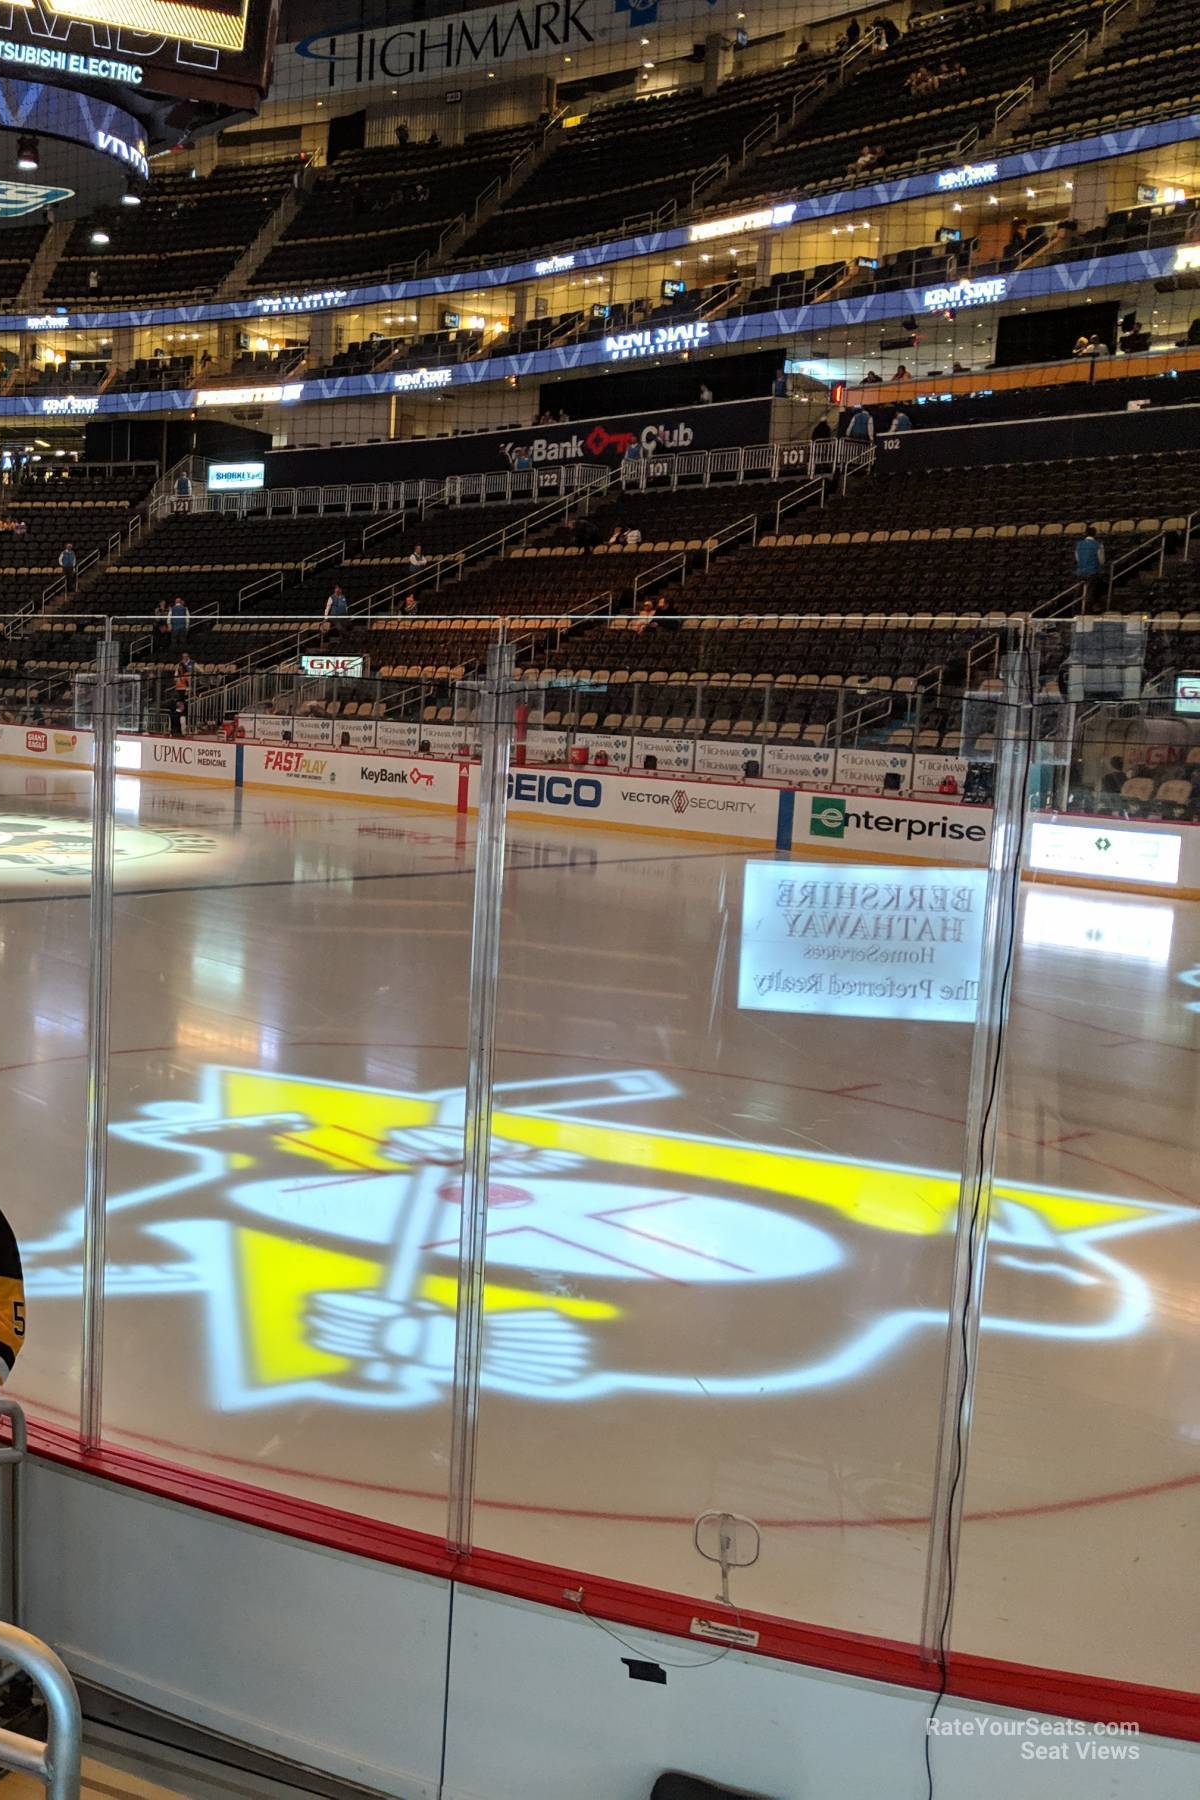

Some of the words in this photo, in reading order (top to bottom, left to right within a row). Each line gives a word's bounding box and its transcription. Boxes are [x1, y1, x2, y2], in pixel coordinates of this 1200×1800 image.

[328, 0, 594, 87] HIGHMARK
[69, 57, 143, 84] ELECTRIC
[883, 439, 900, 450] 102
[782, 450, 804, 465] 101
[539, 474, 558, 487] 122
[27, 734, 46, 742] GIANT
[27, 741, 46, 749] EAGLE
[153, 744, 193, 765] UPMC
[197, 749, 222, 759] SPORTS
[197, 758, 227, 768] MEDICINE
[264, 751, 304, 772] FAST
[300, 759, 328, 775] PLAY
[360, 766, 409, 784] KeyBank
[506, 772, 602, 808] EICO
[621, 791, 670, 806] VECTOR
[812, 806, 987, 842] enterprise
[14, 1301, 25, 1336] 5
